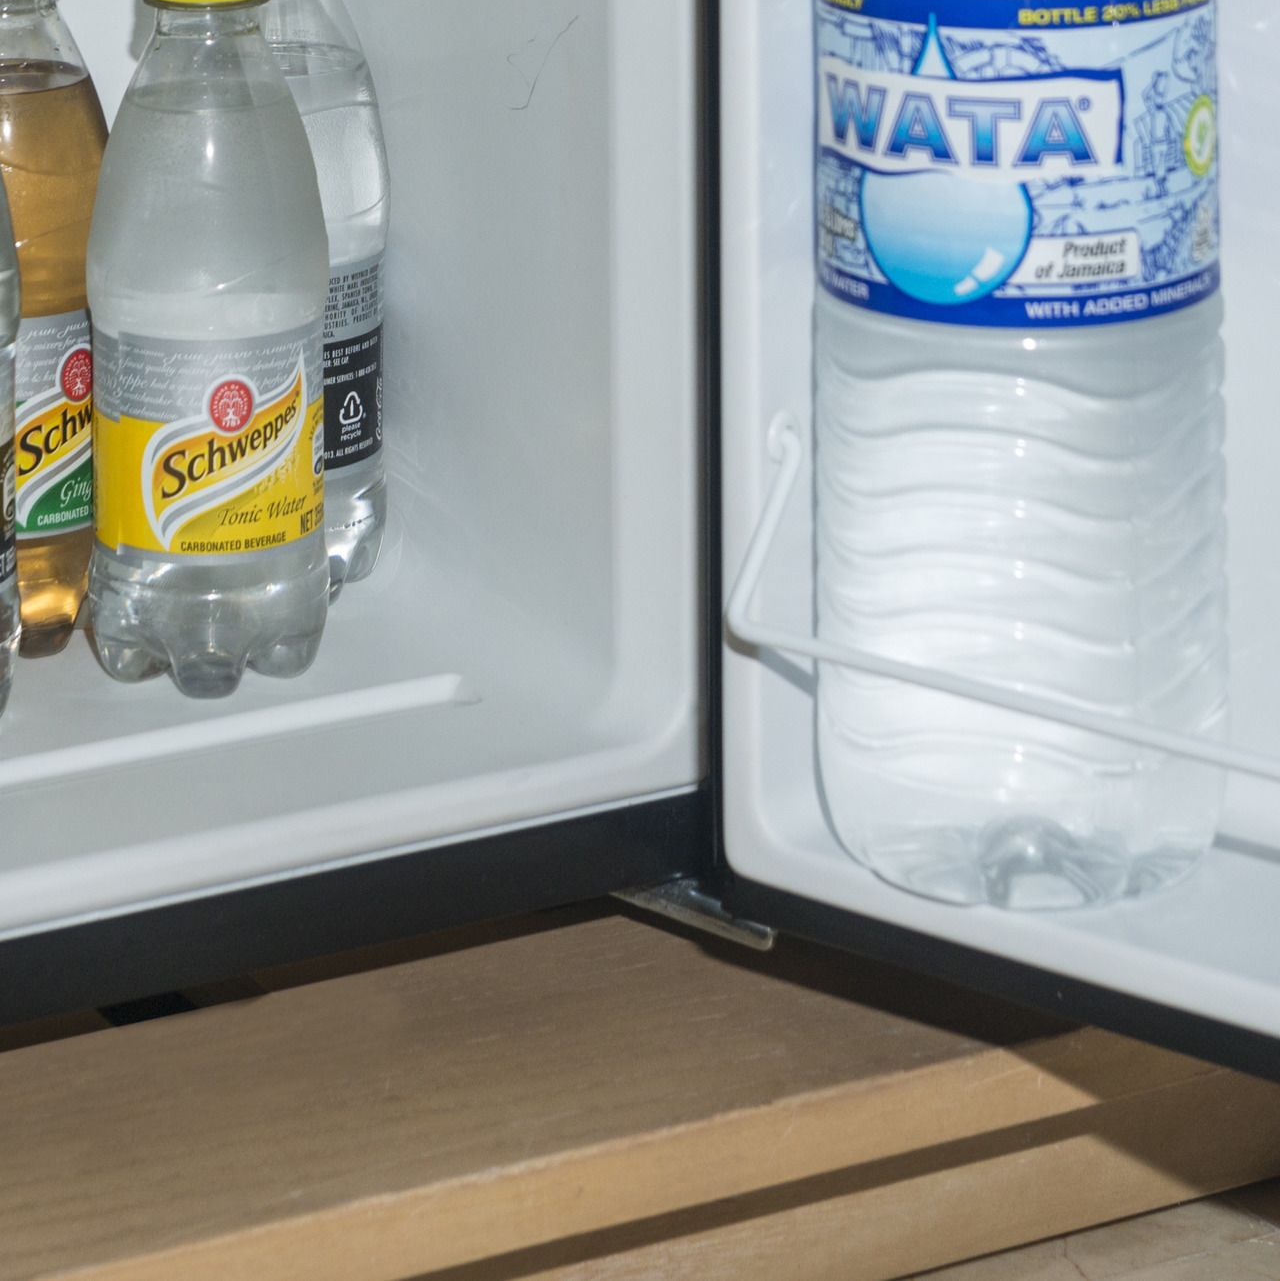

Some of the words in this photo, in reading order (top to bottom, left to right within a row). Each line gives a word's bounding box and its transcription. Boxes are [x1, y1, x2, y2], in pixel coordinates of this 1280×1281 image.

[1018, 6, 1098, 25] BOTTLE
[823, 71, 1100, 169] WATA
[1062, 237, 1127, 258] Product
[1035, 262, 1055, 280] of
[1057, 260, 1126, 279] Jamaica
[1024, 300, 1081, 319] WITH
[1083, 293, 1149, 316] ADDED
[324, 318, 348, 330] USTRIES.
[340, 430, 362, 442] recycle
[341, 421, 361, 434] please
[160, 399, 298, 500] Schweppes
[324, 450, 336, 461] 013.
[59, 475, 92, 508] Ging
[37, 505, 89, 527] CARBONATED
[217, 506, 262, 528] Tonic
[266, 494, 308, 520] Water
[300, 509, 313, 536] NET
[180, 539, 242, 552] CARBONATED
[244, 531, 287, 550] BEVERAGE
